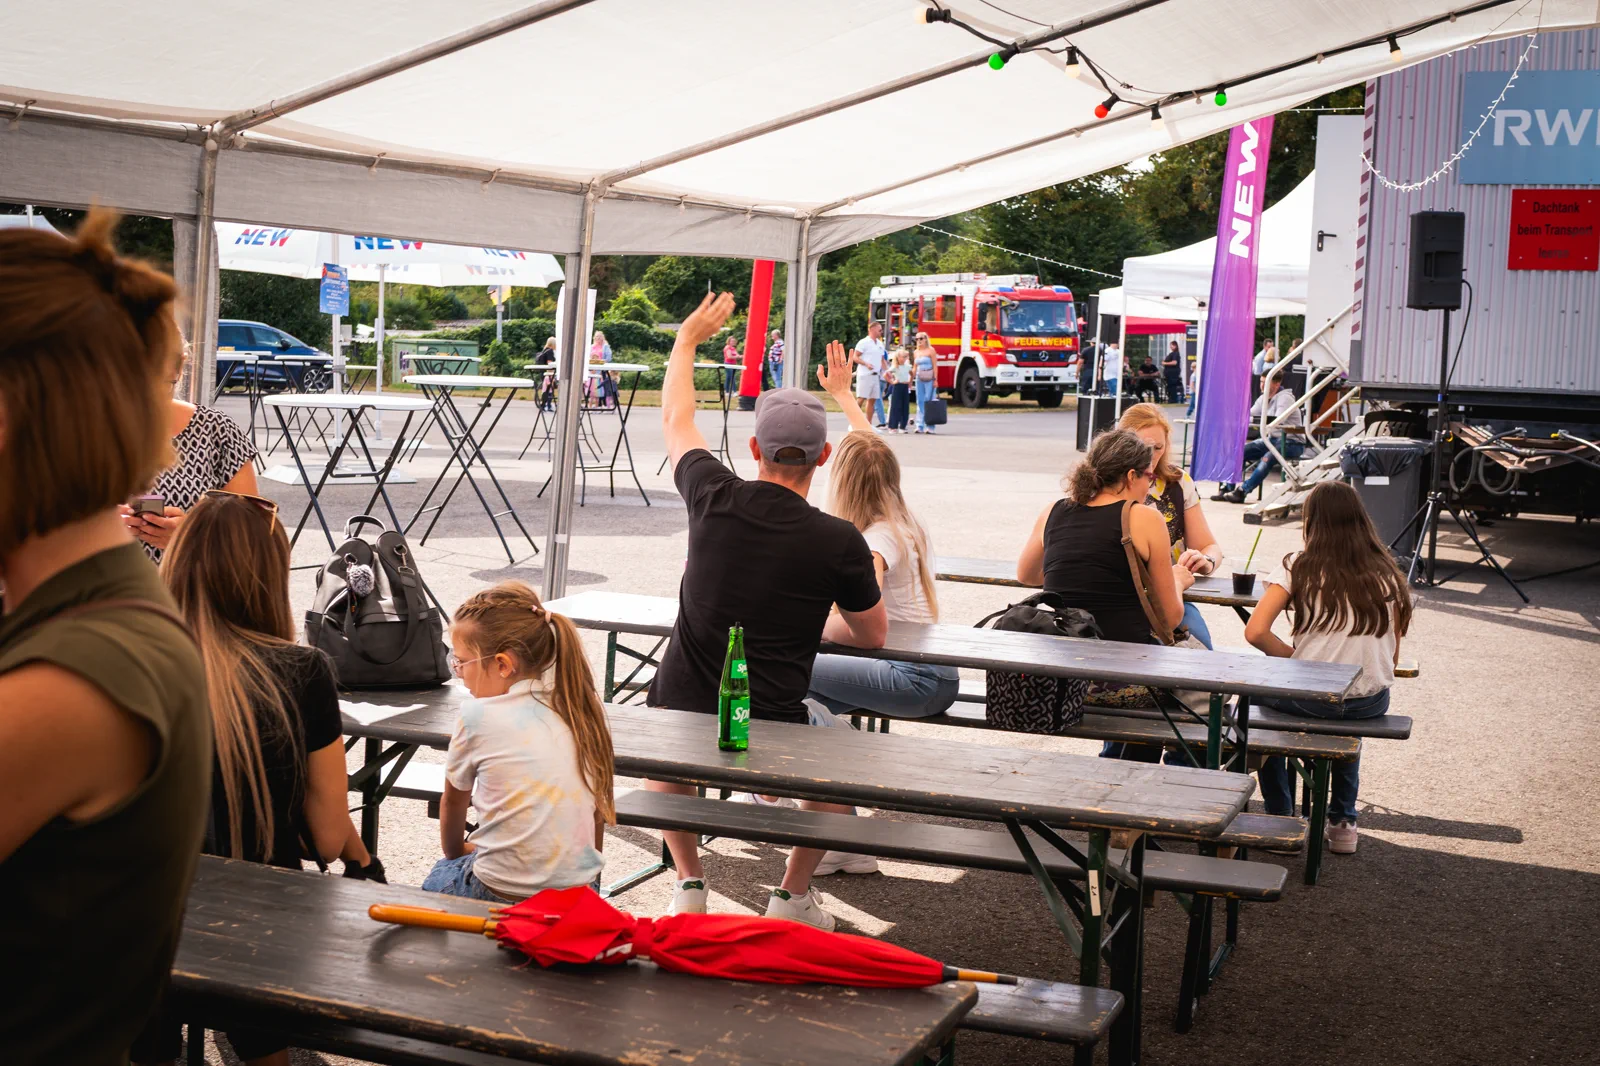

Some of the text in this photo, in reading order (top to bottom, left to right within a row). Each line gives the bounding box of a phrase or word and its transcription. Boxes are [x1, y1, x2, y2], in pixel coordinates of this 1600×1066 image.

[1228, 121, 1259, 259] NEW
[1532, 201, 1580, 213] Dachtank
[234, 228, 294, 247] NEW
[1517, 223, 1593, 238] beim Transport
[1014, 336, 1073, 347] FEUERWEHR
